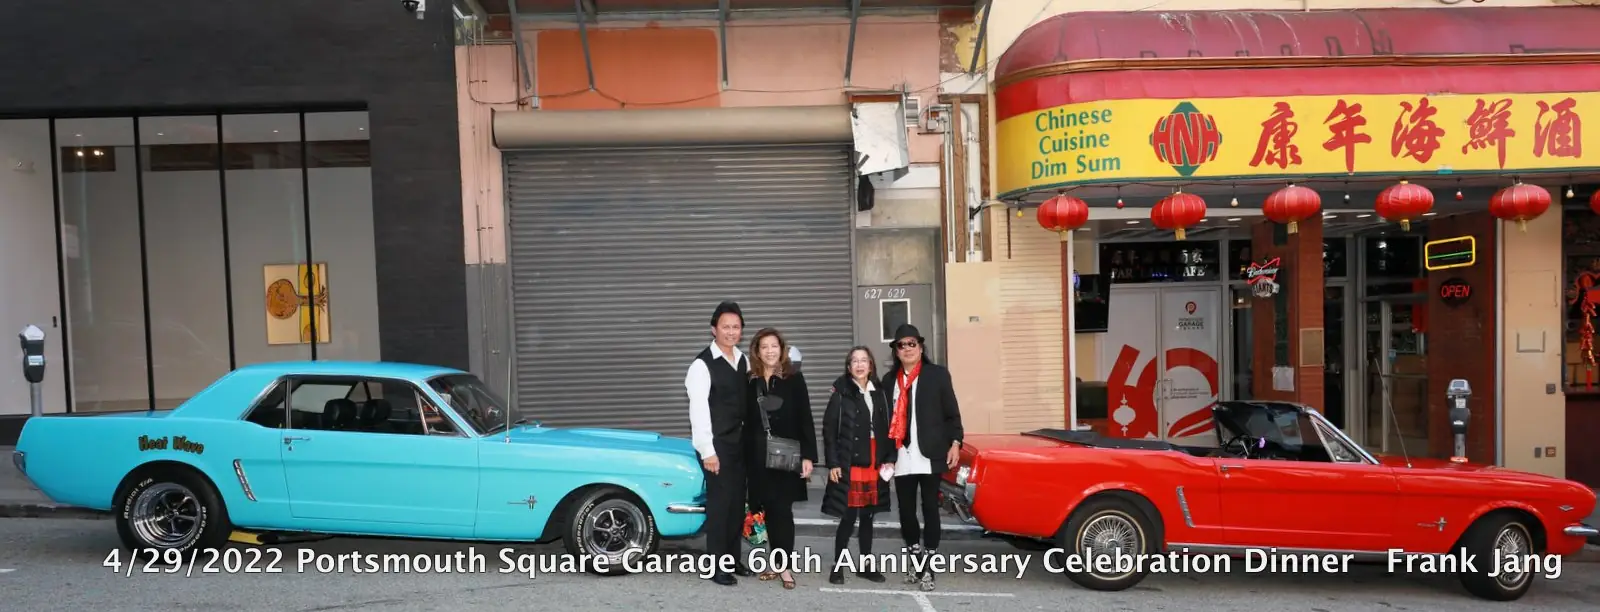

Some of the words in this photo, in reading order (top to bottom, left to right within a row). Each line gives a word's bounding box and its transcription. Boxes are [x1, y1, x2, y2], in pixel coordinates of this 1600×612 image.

[1035, 108, 1113, 132] Chinese
[1039, 131, 1110, 155] Cuisine
[1152, 111, 1221, 167] HNH
[1031, 159, 1067, 180] Dim
[1076, 154, 1121, 174] Sum
[864, 288, 882, 299] 627
[888, 288, 905, 298] 629
[1441, 284, 1470, 298] OPEN
[138, 435, 168, 451] Heat
[173, 436, 204, 454] Wave
